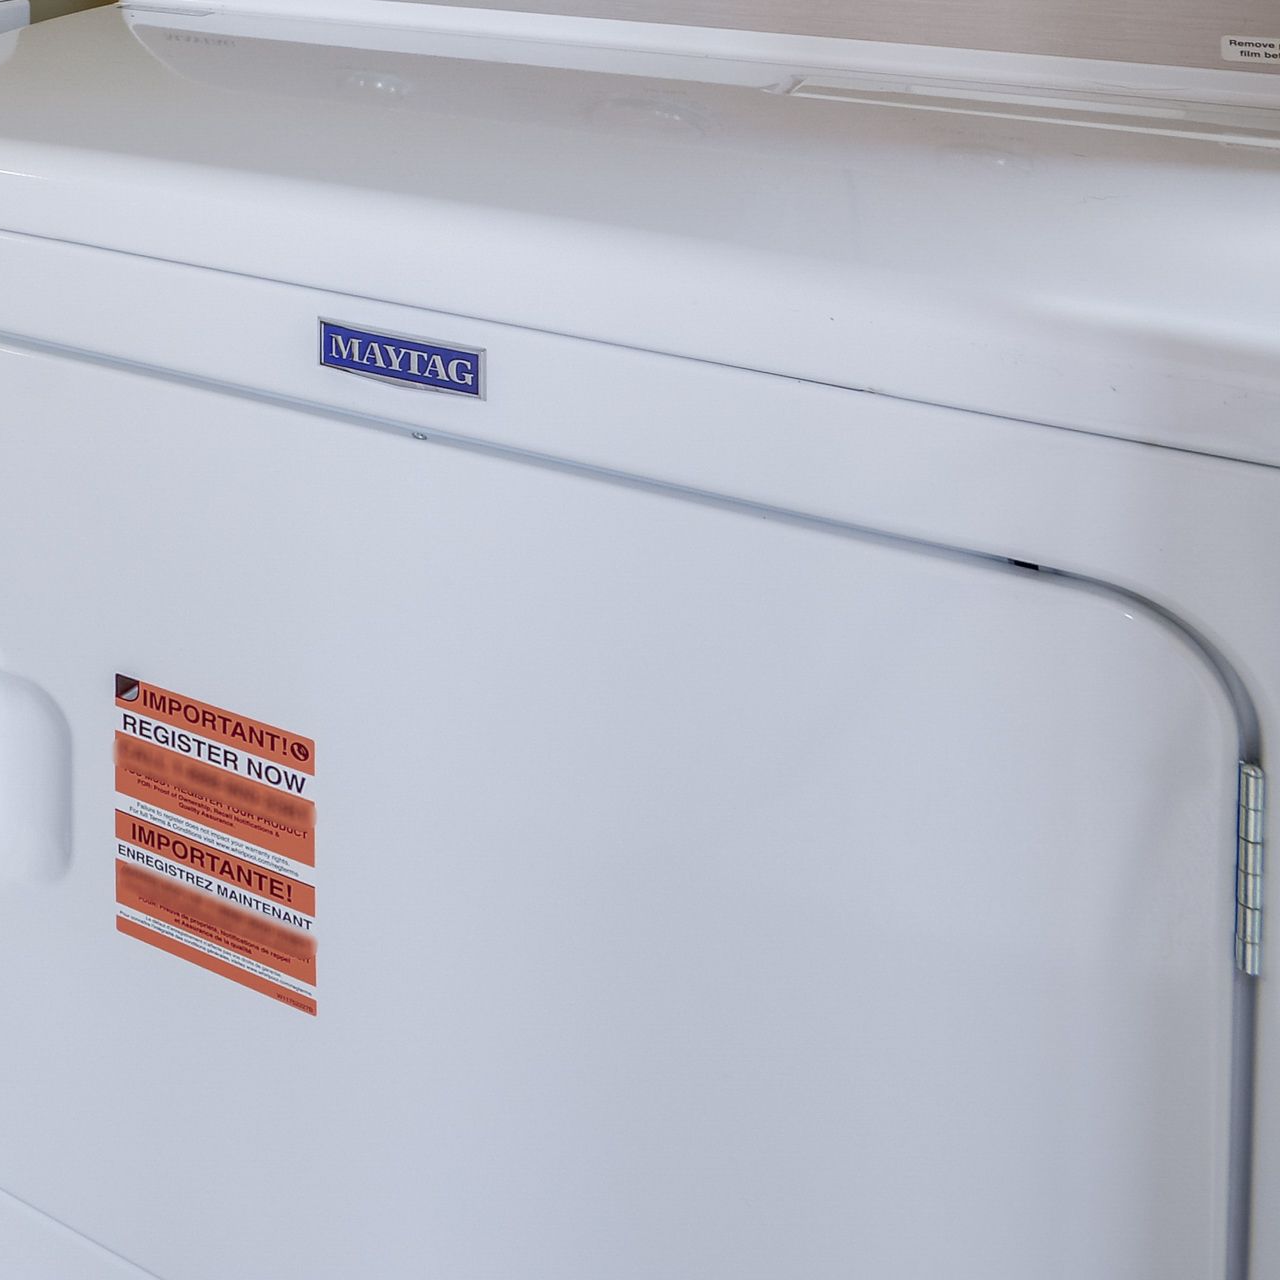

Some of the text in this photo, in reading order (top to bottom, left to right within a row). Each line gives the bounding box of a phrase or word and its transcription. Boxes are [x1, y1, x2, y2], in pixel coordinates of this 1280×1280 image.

[1229, 39, 1276, 49] Remove
[1240, 50, 1261, 58] film
[328, 333, 475, 386] MAYTAG
[142, 688, 287, 756] IMPORTANT!
[122, 712, 306, 796] REGISTER NOW
[149, 813, 165, 825] Terms
[172, 822, 202, 839] Conditions
[153, 783, 169, 796] Proof
[213, 807, 233, 820] Recall
[233, 814, 273, 836] Notifications
[178, 800, 200, 815] Quality
[163, 811, 184, 826] register
[184, 819, 199, 831] does
[230, 839, 243, 849] your
[244, 844, 270, 860] warranty
[117, 842, 312, 933] ENREGISTREZ MAINTENANT
[131, 821, 292, 904] IMPORTANTE!
